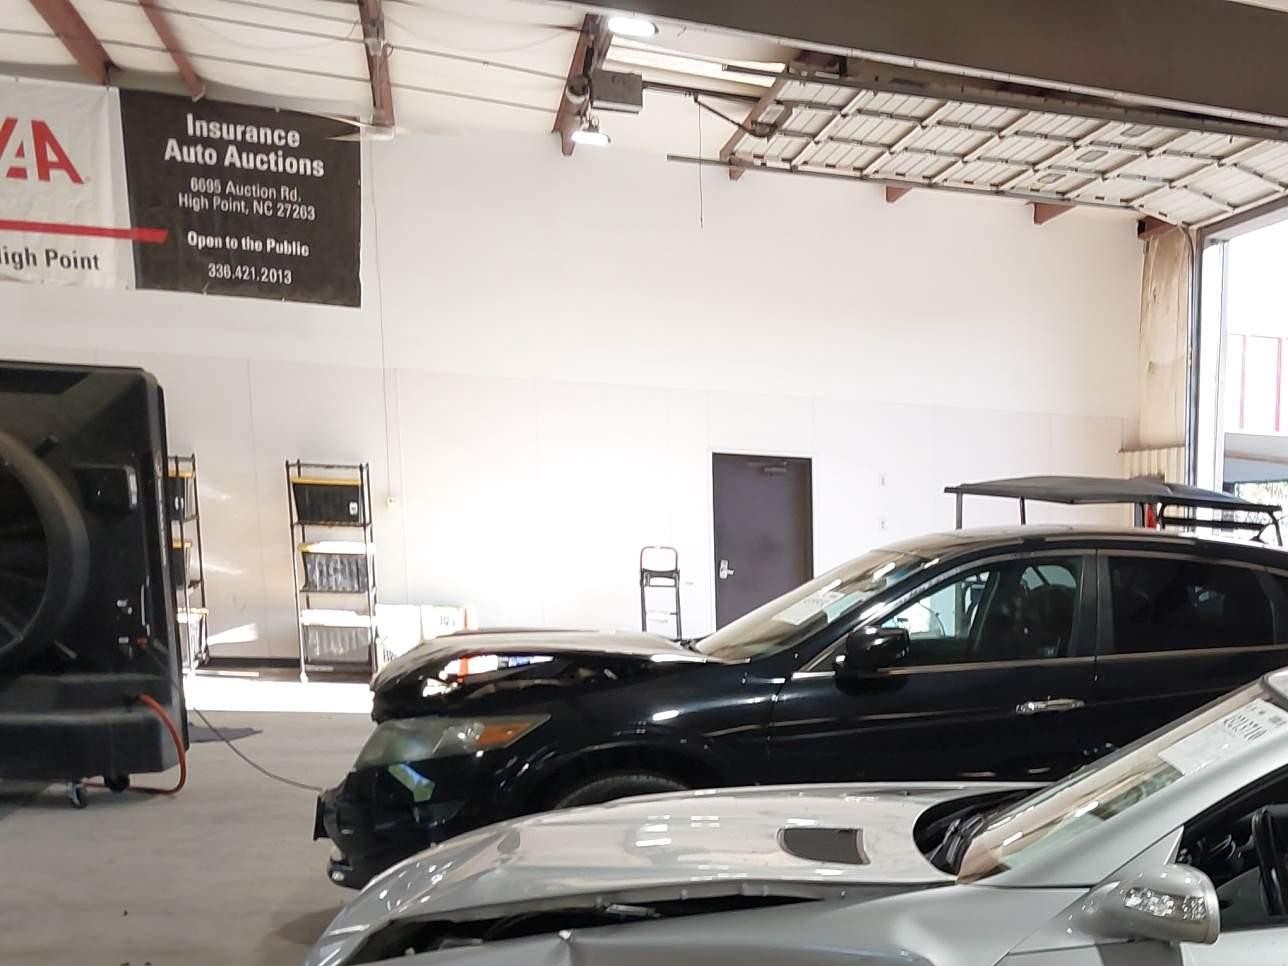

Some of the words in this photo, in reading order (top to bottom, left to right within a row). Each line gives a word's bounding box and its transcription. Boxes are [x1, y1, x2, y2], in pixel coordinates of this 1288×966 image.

[186, 113, 300, 148] Insurance
[164, 138, 217, 166] Auto
[223, 145, 325, 177] Auctions
[225, 180, 277, 200] Auction
[178, 192, 209, 212] High
[213, 195, 250, 216] Point,
[253, 199, 273, 217] NC
[277, 202, 316, 220] 27263
[187, 230, 222, 250] Open
[225, 235, 239, 250] to
[241, 236, 263, 252] the
[266, 238, 310, 257] Public
[0, 245, 37, 270] igh
[45, 248, 100, 270] Point
[208, 262, 292, 285] 336.421.2013
